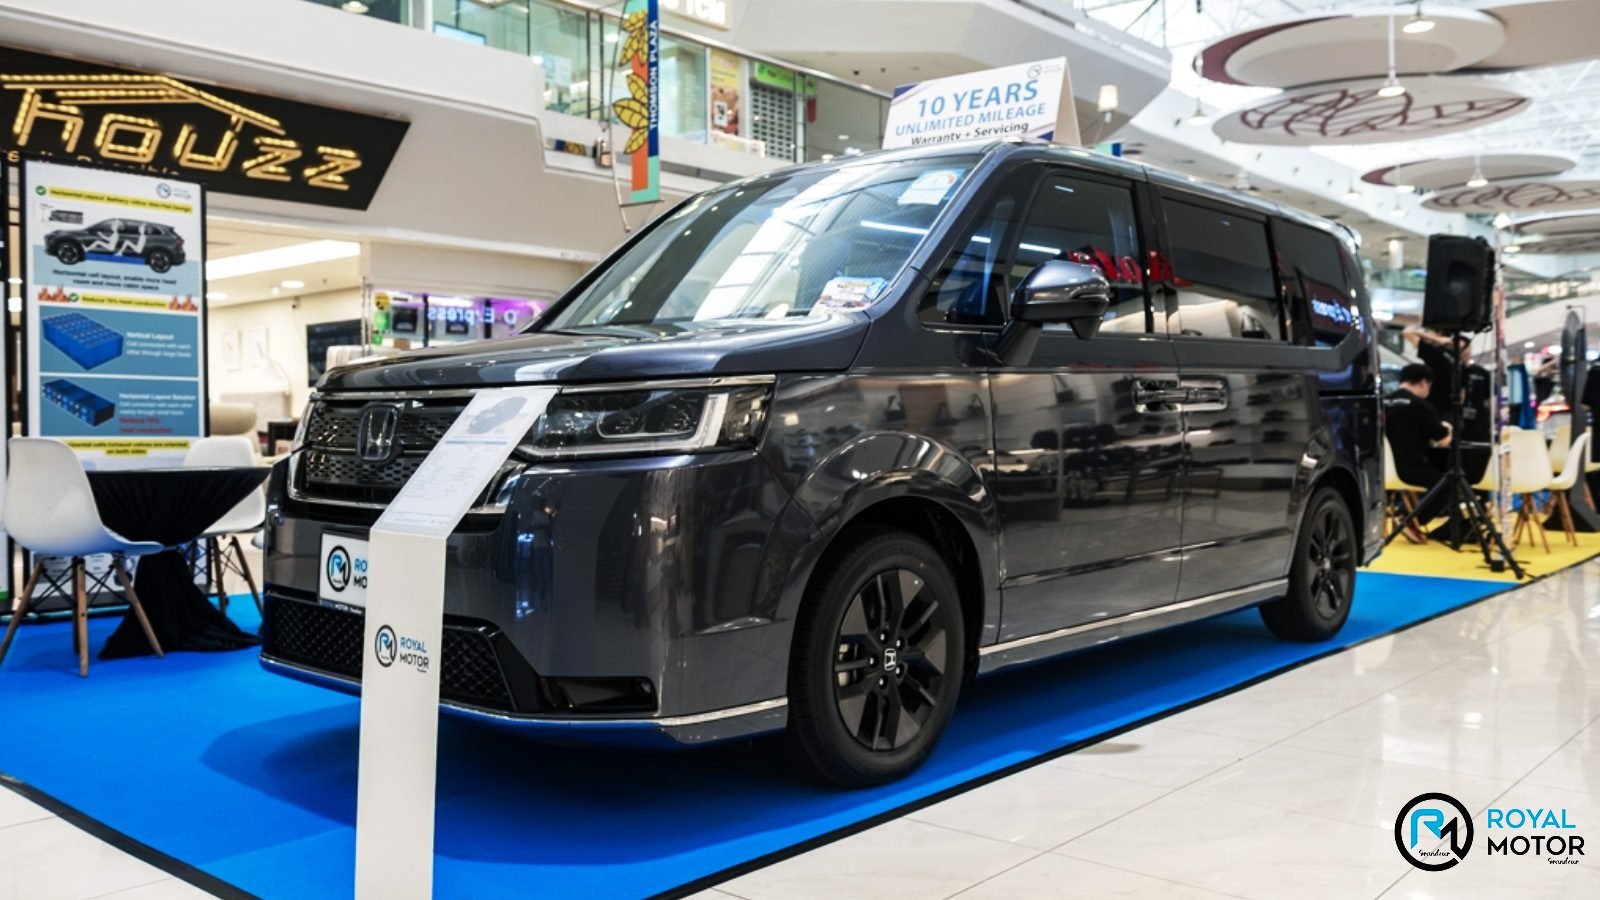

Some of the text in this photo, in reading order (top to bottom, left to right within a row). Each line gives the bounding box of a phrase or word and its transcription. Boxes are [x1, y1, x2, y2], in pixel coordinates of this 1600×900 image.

[649, 19, 658, 130] THOMSON PLAZA
[918, 79, 1038, 117] 10 YEARS
[895, 102, 1047, 136] UNLIMITED MILEAGE
[12, 84, 362, 191] houzz
[911, 131, 960, 146] Warranty
[974, 122, 1029, 138] Servicing
[354, 558, 367, 572] RO
[353, 576, 367, 589] MO
[400, 636, 427, 653] ROYAL
[399, 652, 429, 669] MOTOR
